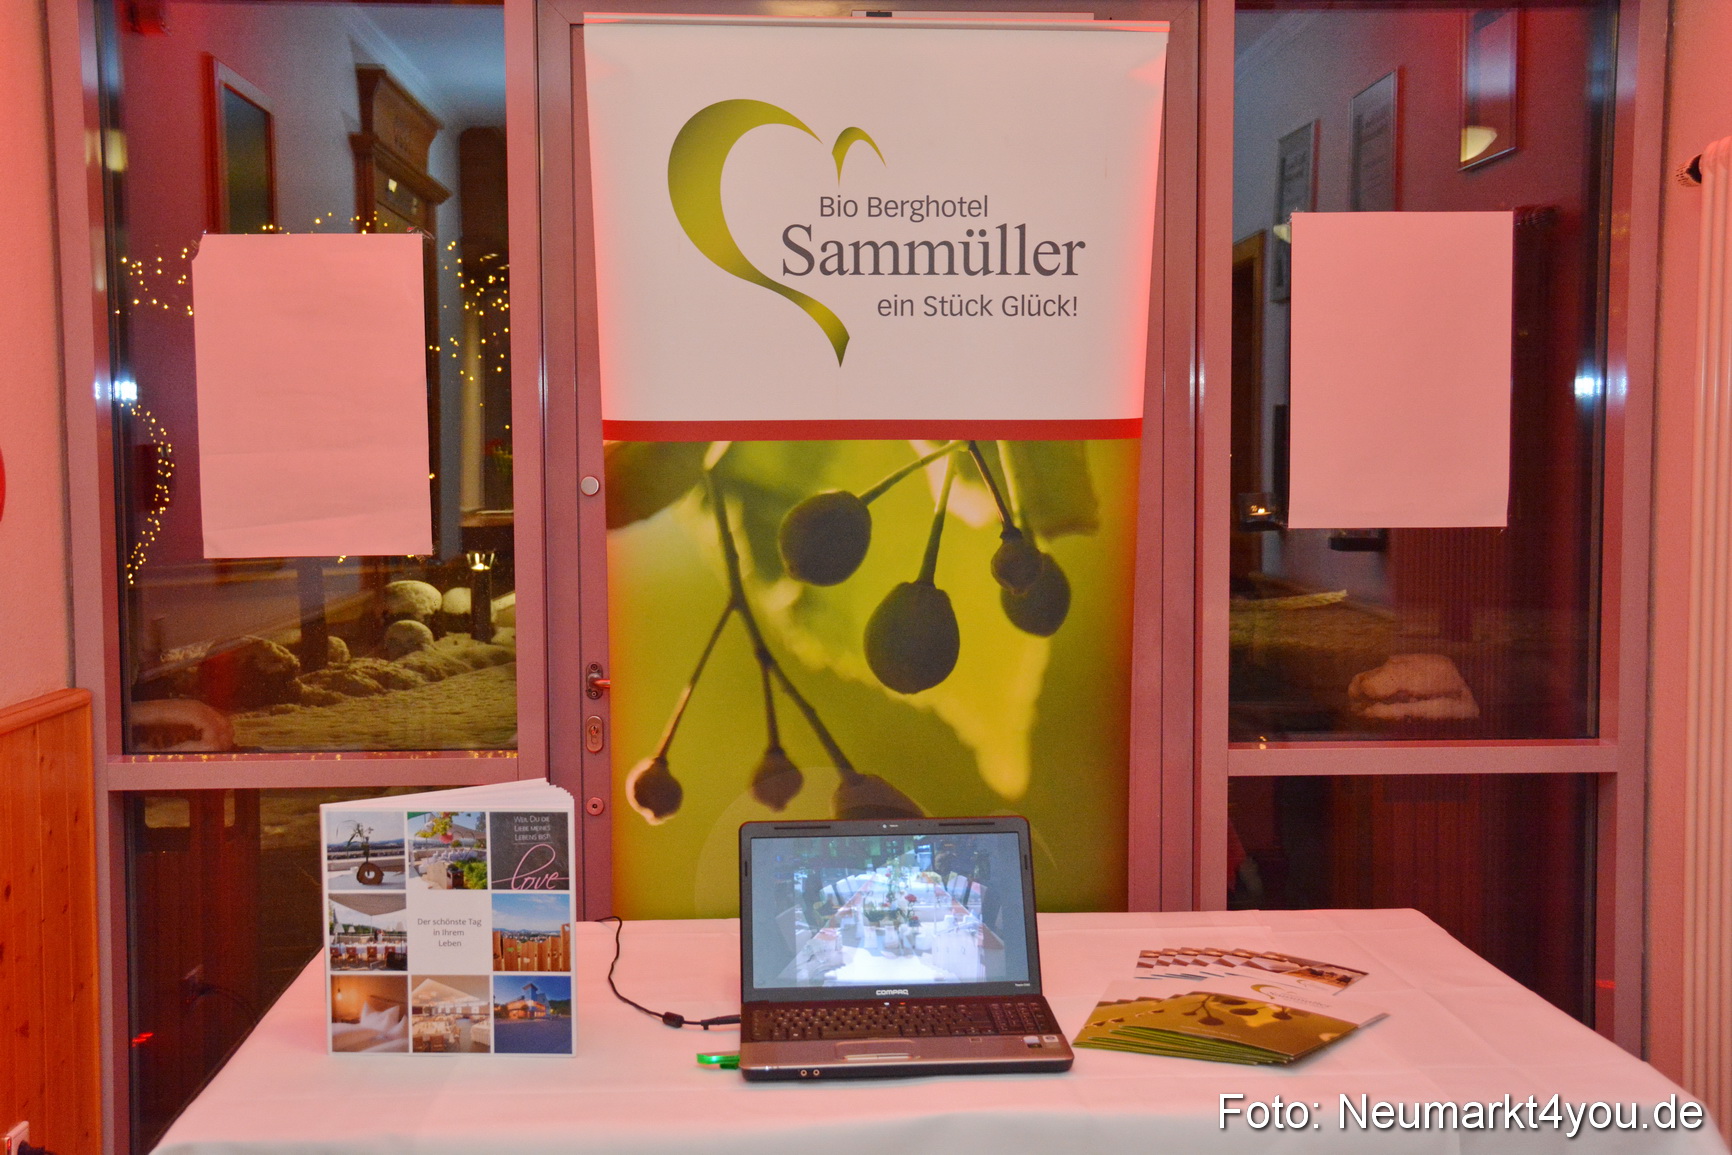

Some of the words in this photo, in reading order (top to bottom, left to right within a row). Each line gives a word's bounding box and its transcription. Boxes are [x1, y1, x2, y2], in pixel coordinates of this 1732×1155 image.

[820, 194, 859, 218] Bio
[867, 194, 988, 223] Berghotel
[782, 222, 1086, 277] Sammüller
[877, 295, 914, 317] ein
[923, 294, 994, 317] Stück
[1001, 294, 1078, 317] Glück!
[469, 918, 482, 927] Tag
